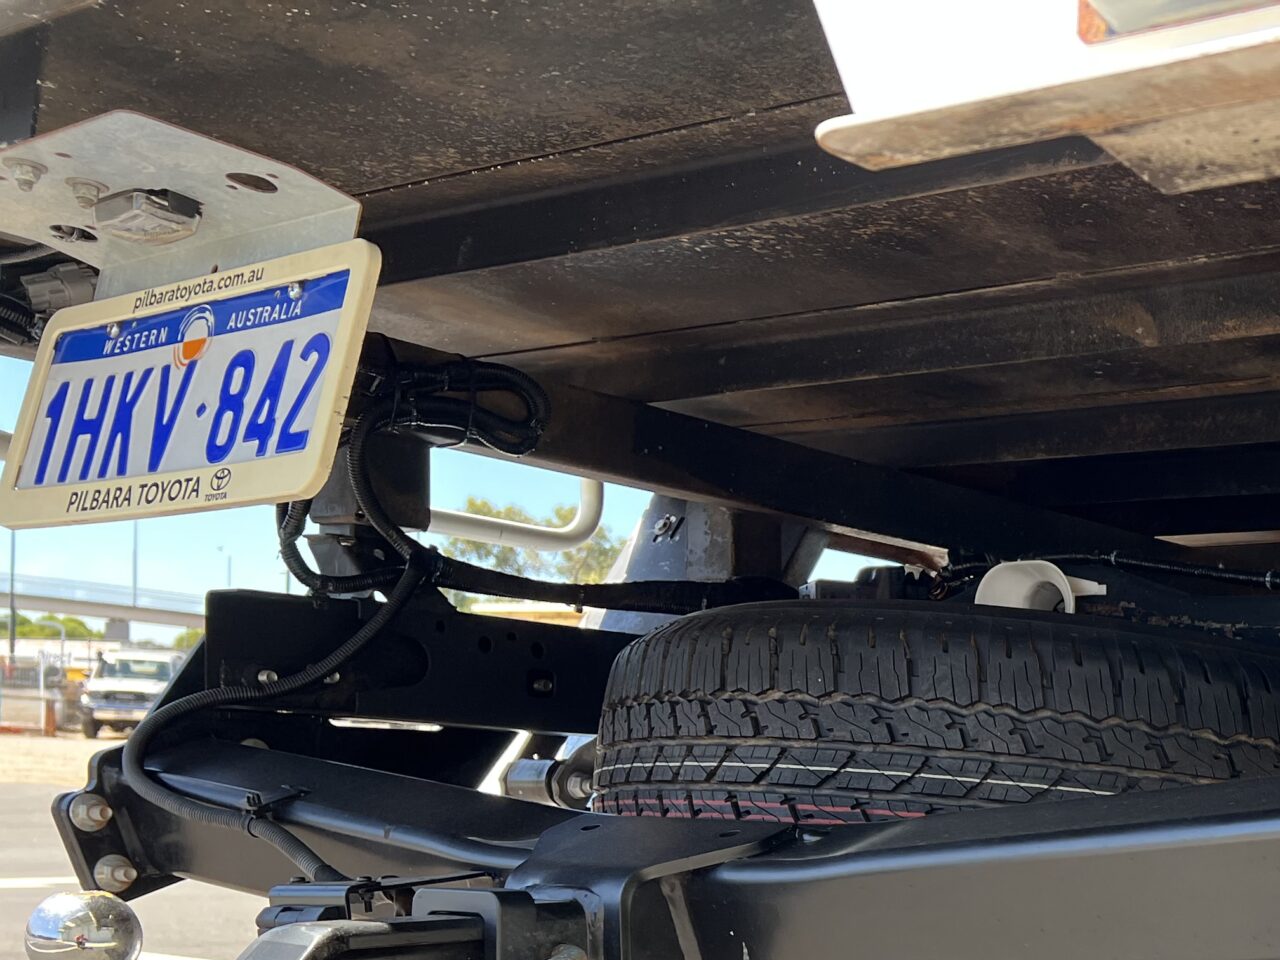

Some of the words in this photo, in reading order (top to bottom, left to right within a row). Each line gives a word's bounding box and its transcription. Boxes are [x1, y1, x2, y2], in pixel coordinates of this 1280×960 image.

[132, 267, 265, 313] pilbaratoyota.com.au
[103, 326, 169, 356] WESTERN
[227, 300, 302, 330] AUSTRALIA
[65, 485, 133, 513] PILBARA
[137, 476, 201, 506] TOYOTA
[204, 491, 228, 502] TOYOTA
